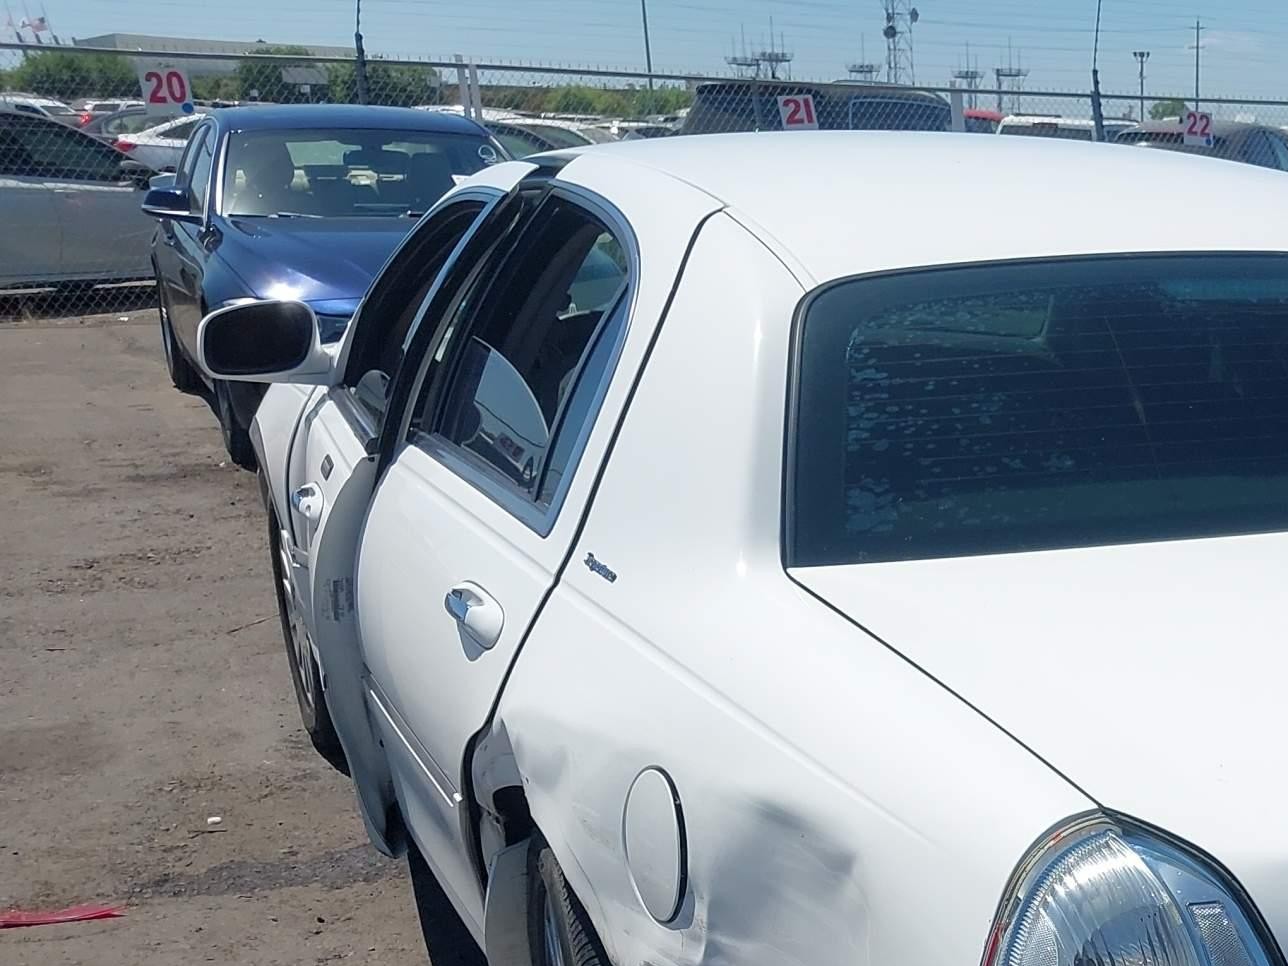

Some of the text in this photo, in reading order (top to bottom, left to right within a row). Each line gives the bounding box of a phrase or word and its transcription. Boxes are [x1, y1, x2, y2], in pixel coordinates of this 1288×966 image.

[145, 71, 187, 104] 20
[783, 97, 814, 125] 21
[1186, 112, 1210, 137] 22
